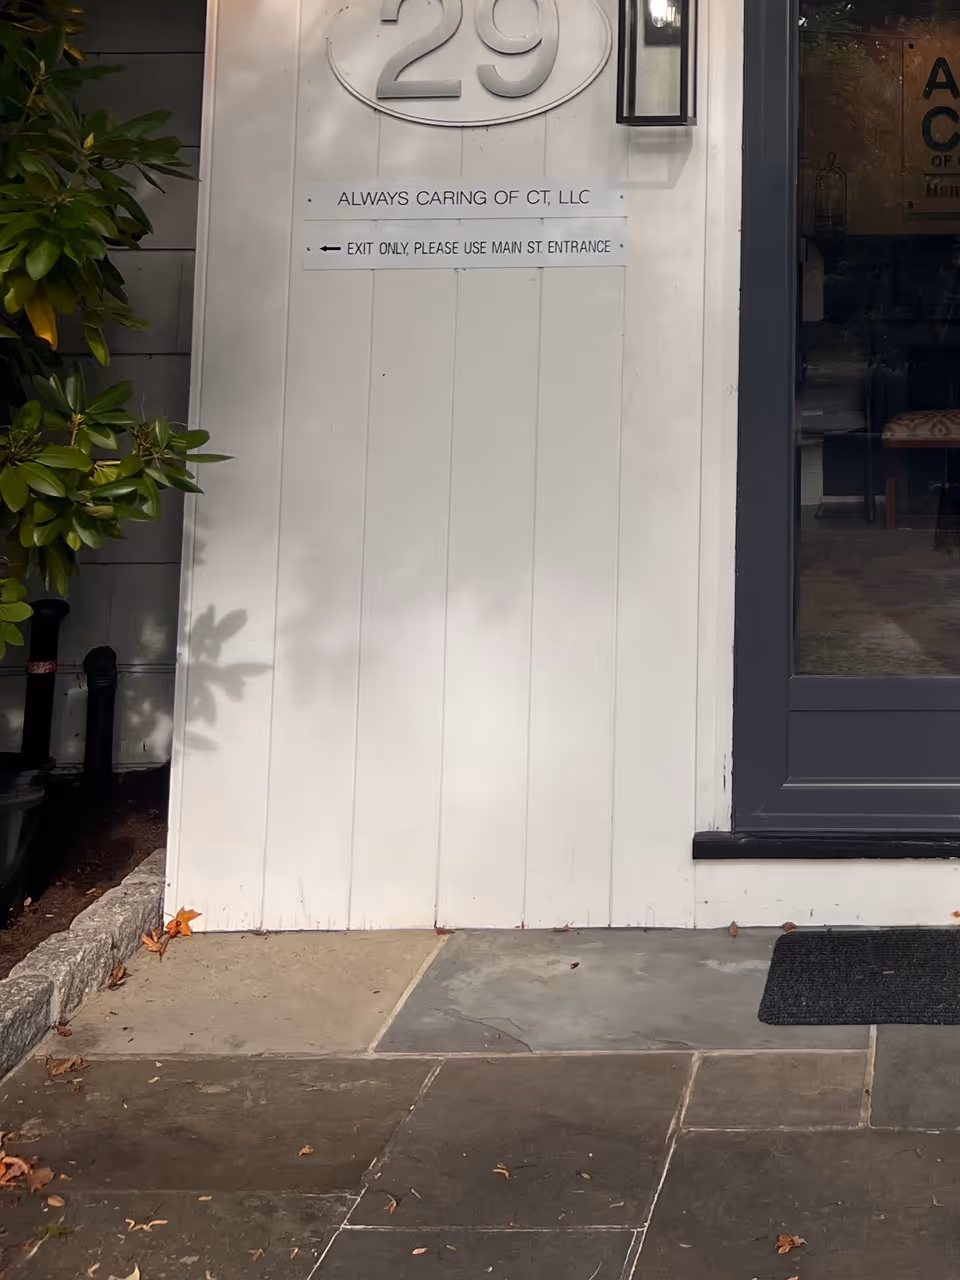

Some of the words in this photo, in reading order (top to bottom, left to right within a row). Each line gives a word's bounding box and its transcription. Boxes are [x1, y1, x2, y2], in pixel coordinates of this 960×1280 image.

[930, 154, 952, 168] OF
[337, 190, 410, 206] ALWAYS
[416, 190, 487, 206] CARING
[493, 189, 520, 205] OF
[526, 189, 551, 207] CT,
[558, 189, 591, 205] LLC
[347, 241, 374, 255] EXIT
[379, 241, 409, 256] ONLY,
[414, 241, 460, 255] PLEASE
[464, 240, 487, 255] USE
[491, 240, 522, 254] MAIN
[527, 240, 543, 254] ST.
[547, 239, 612, 254] ENTRANCE
